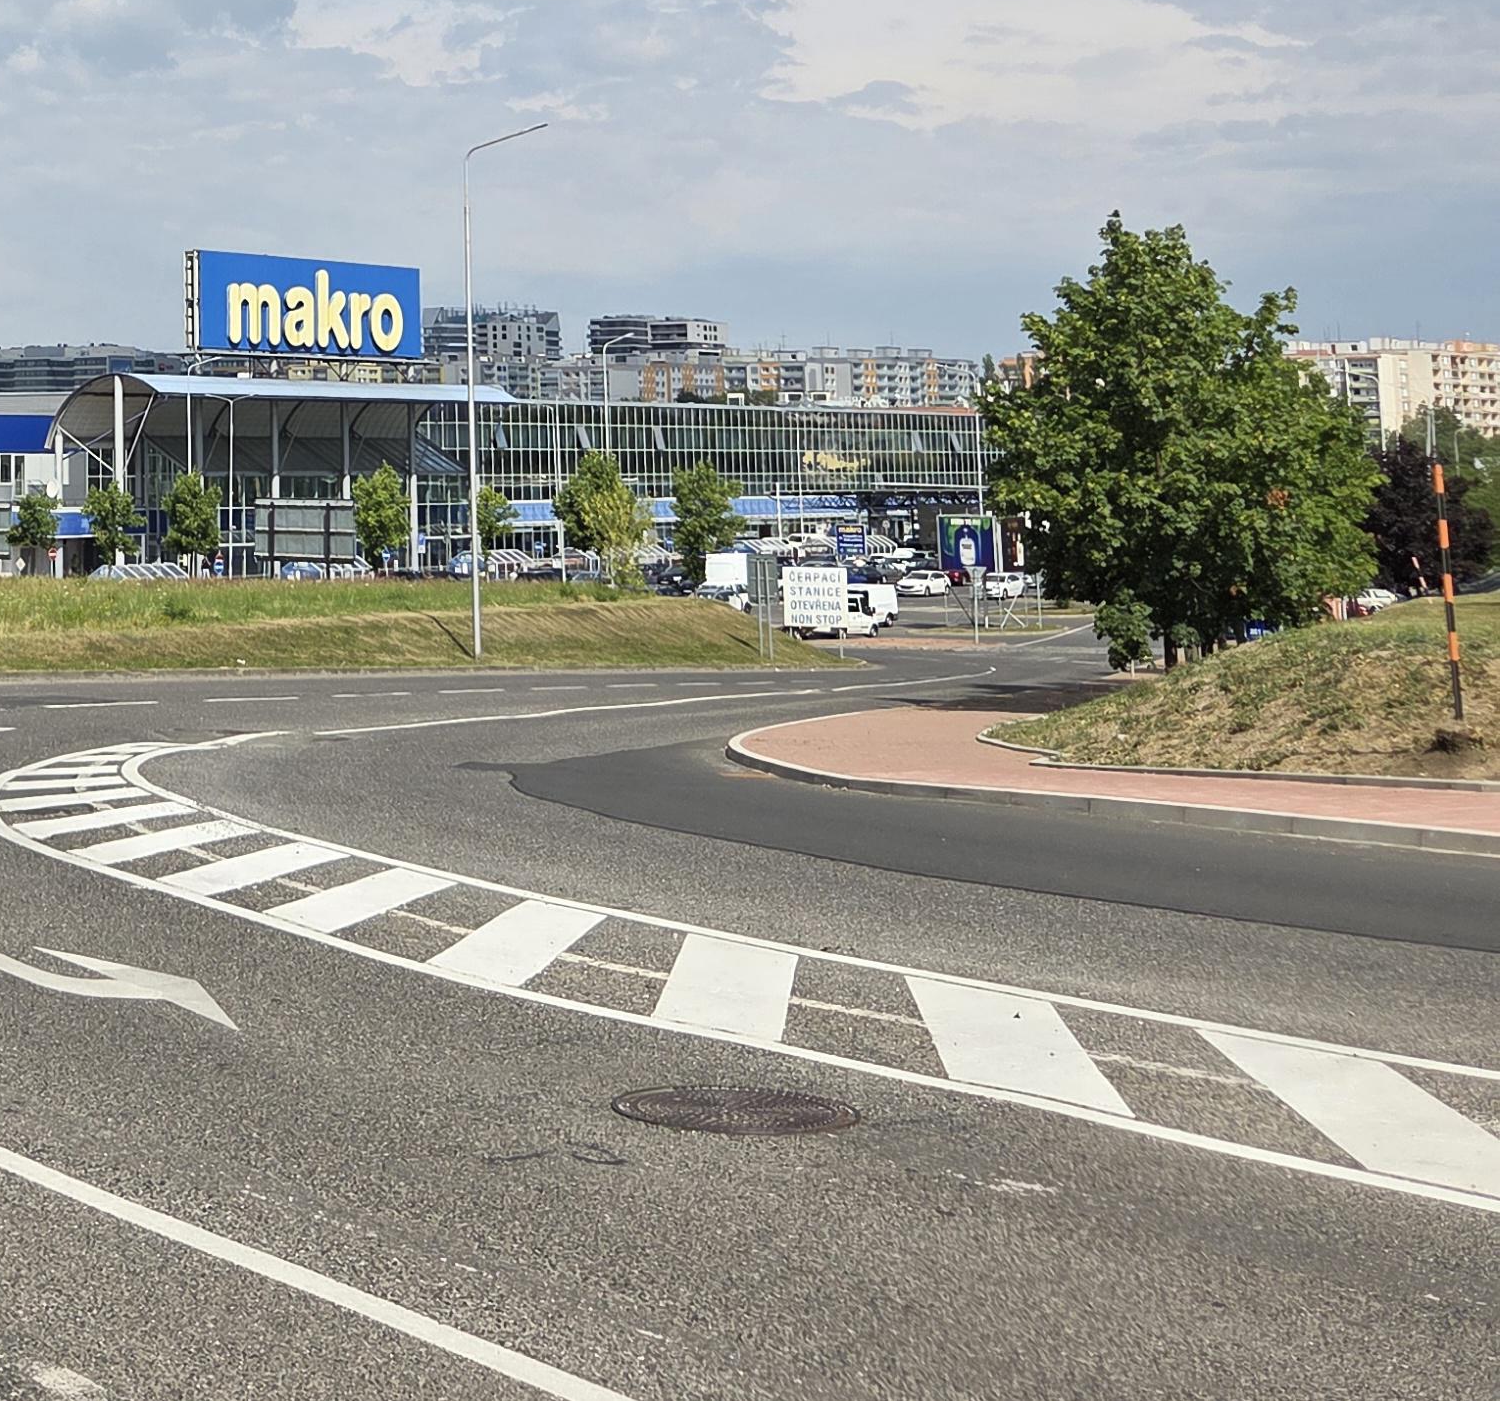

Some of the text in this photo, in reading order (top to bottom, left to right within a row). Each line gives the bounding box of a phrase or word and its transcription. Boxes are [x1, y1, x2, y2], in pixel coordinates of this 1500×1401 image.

[227, 269, 404, 352] makro
[789, 570, 841, 583] ČERPACÍ
[789, 586, 841, 597] STANICE
[791, 613, 842, 625] NON STOP
